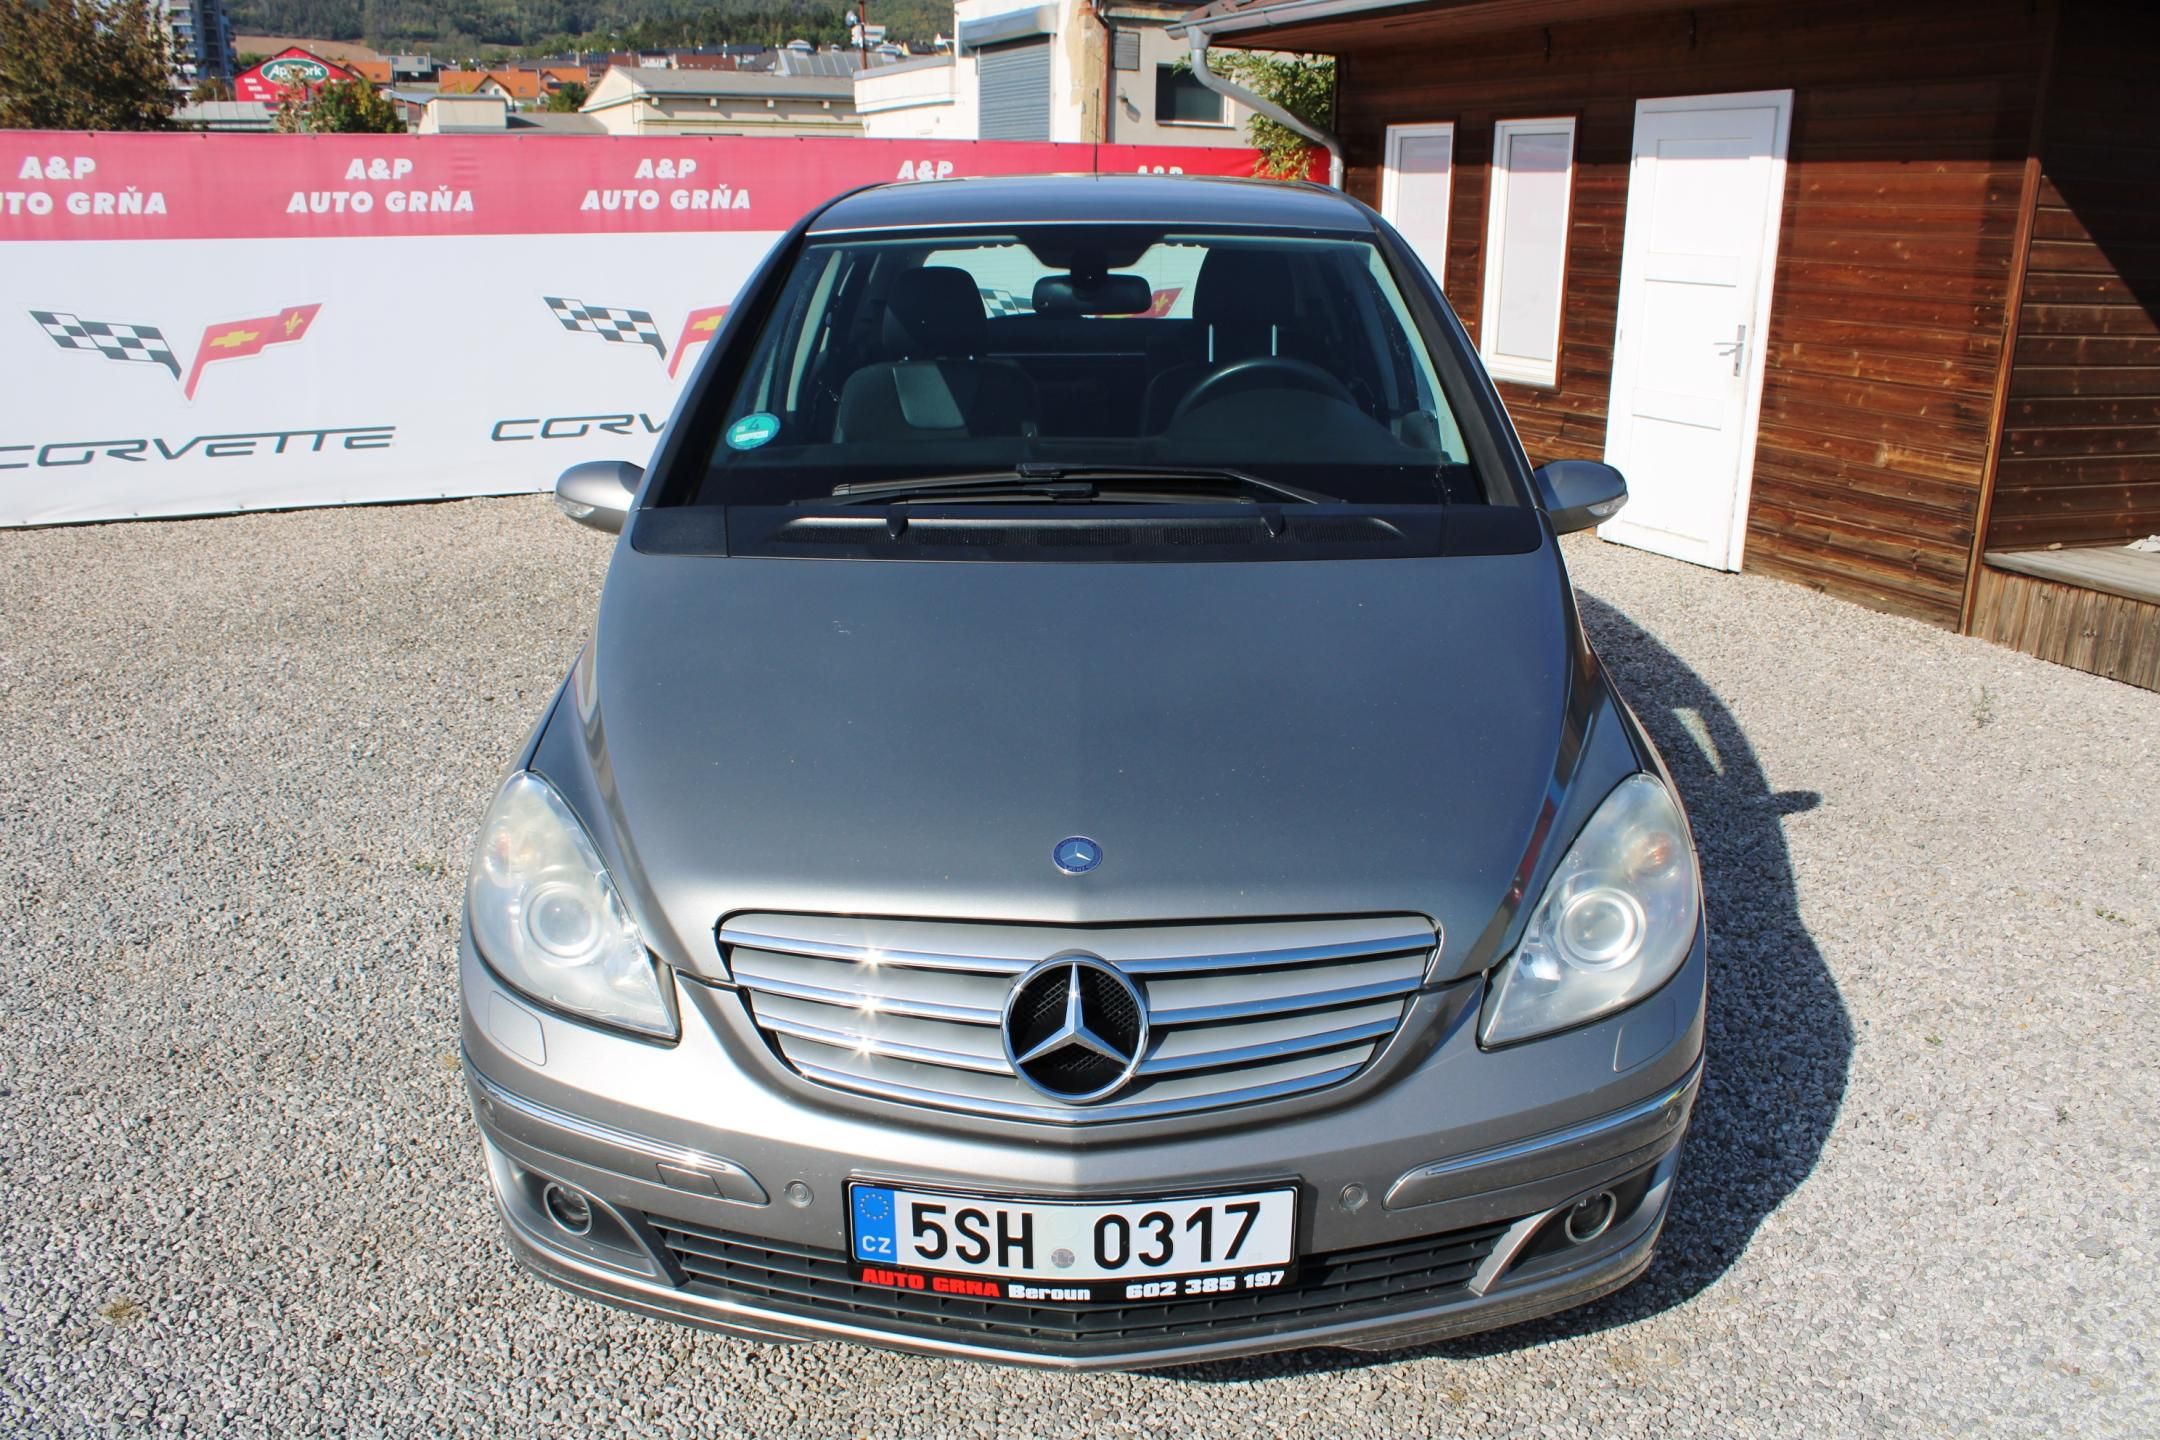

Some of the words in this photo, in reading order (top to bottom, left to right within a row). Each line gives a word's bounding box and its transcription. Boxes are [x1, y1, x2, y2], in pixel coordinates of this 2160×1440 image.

[18, 156, 96, 180] A&P
[345, 158, 413, 180] A&P
[634, 158, 697, 179] A&P
[897, 160, 954, 181] A&P
[0, 191, 54, 215] TO
[66, 185, 167, 215] GRŇA
[286, 191, 374, 213] AUTO
[385, 184, 474, 213] GRŇA
[580, 189, 660, 211] AUTO
[670, 183, 750, 210] GRŇA
[491, 412, 668, 442] CORV
[861, 1235, 892, 1254] CZ
[911, 1201, 1034, 1270] 5SH
[1093, 1200, 1261, 1271] 0317
[862, 1267, 925, 1290] AUTO
[1008, 1283, 1091, 1301] Beroun
[1126, 1280, 1178, 1300] 602
[1184, 1275, 1237, 1295] 385
[1243, 1269, 1286, 1289] 197
